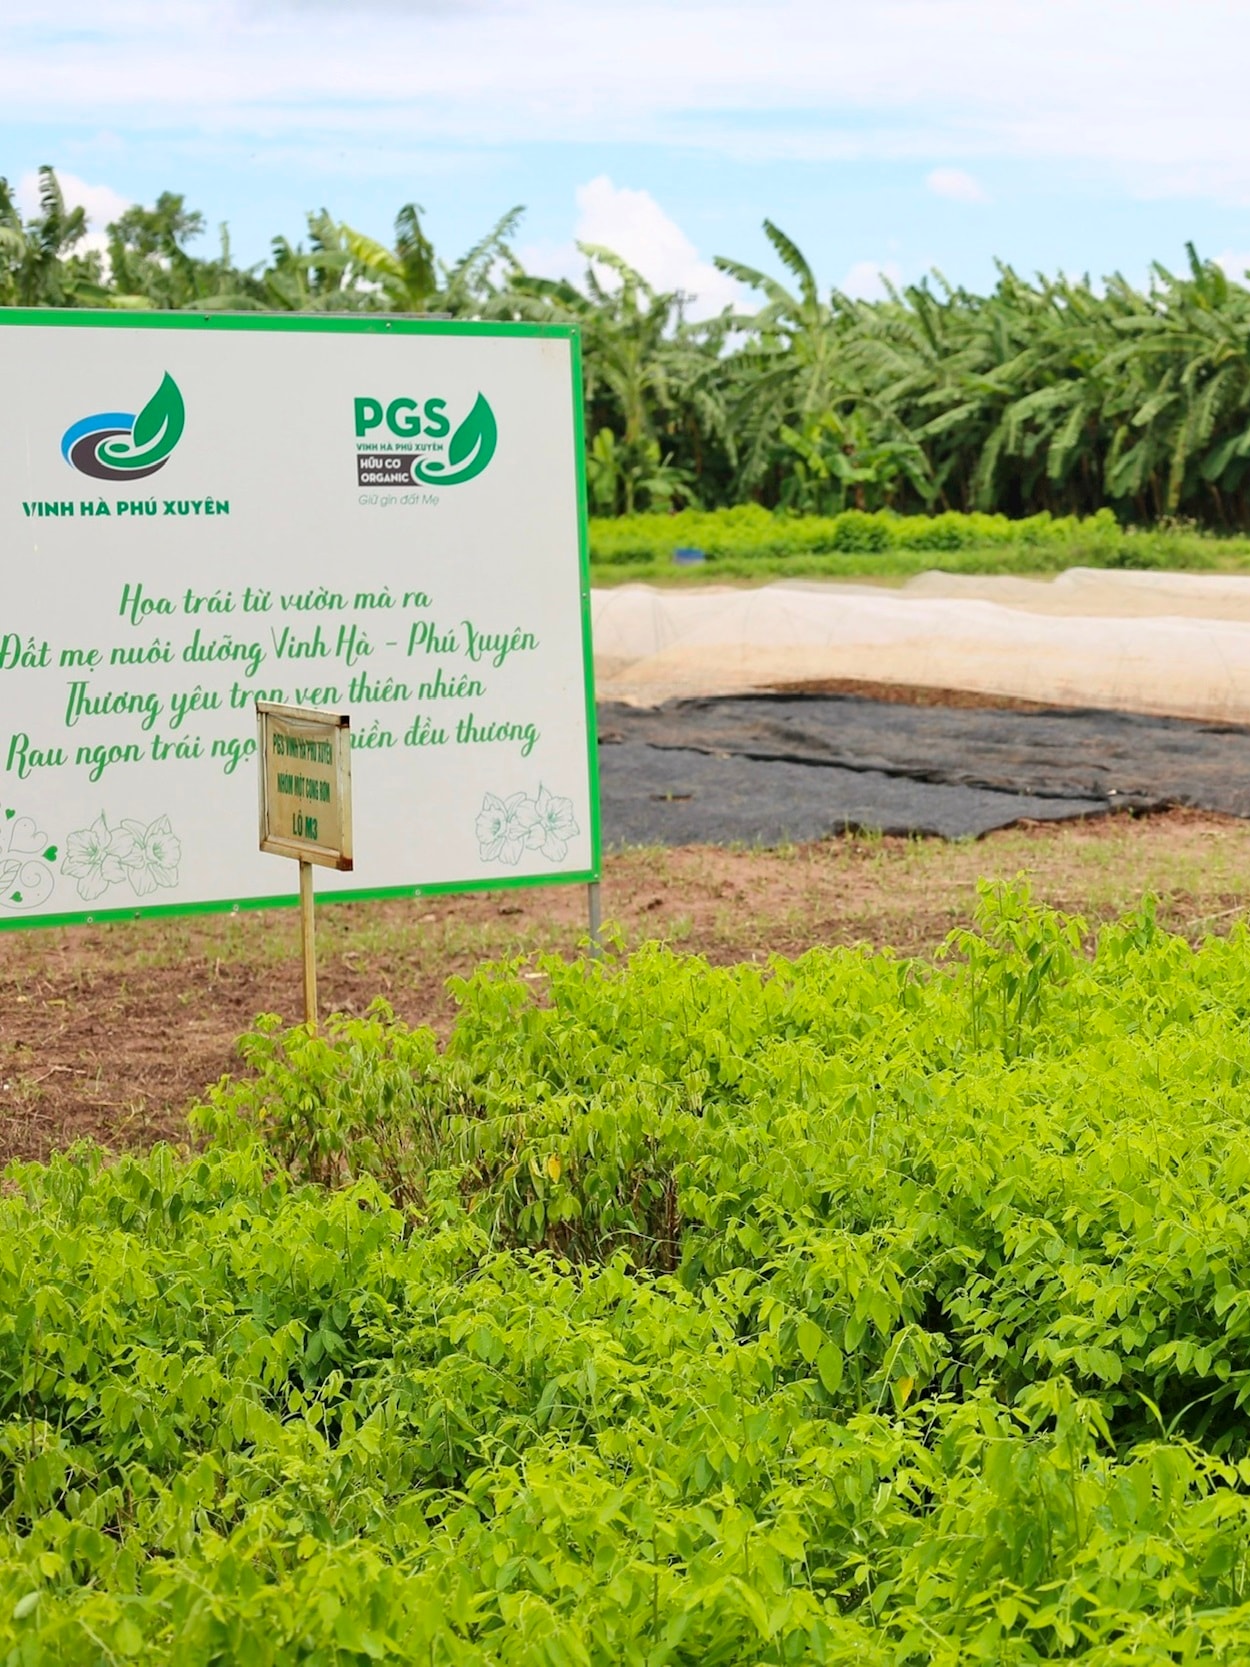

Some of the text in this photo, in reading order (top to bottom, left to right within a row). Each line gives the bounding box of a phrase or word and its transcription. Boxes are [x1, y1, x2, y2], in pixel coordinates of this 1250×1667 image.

[354, 397, 450, 438] PGS
[361, 473, 409, 483] ORGANIC
[22, 496, 230, 517] VINH HÀ PHÚ XUYÊN
[183, 588, 236, 614] trái
[243, 587, 273, 612] từ
[280, 586, 348, 611] vườn
[353, 586, 396, 609] mà
[402, 592, 432, 608] ra
[0, 633, 52, 669] Đất
[59, 649, 103, 673] mẹ
[109, 638, 175, 665] nuôi
[182, 628, 267, 678] dưỡng
[271, 625, 331, 659] Vinh
[335, 624, 374, 666] Hà
[407, 621, 460, 656] Phú
[460, 620, 540, 668] Xuyên
[65, 681, 164, 731] Thương
[169, 685, 222, 729] yêu
[347, 670, 413, 703] thiên
[418, 668, 487, 700] nhiên
[6, 732, 67, 780] Rau
[75, 744, 145, 783] ngon
[151, 734, 205, 761] trái
[211, 738, 257, 775] ngọ
[404, 714, 450, 746] đều
[456, 712, 541, 758] thương
